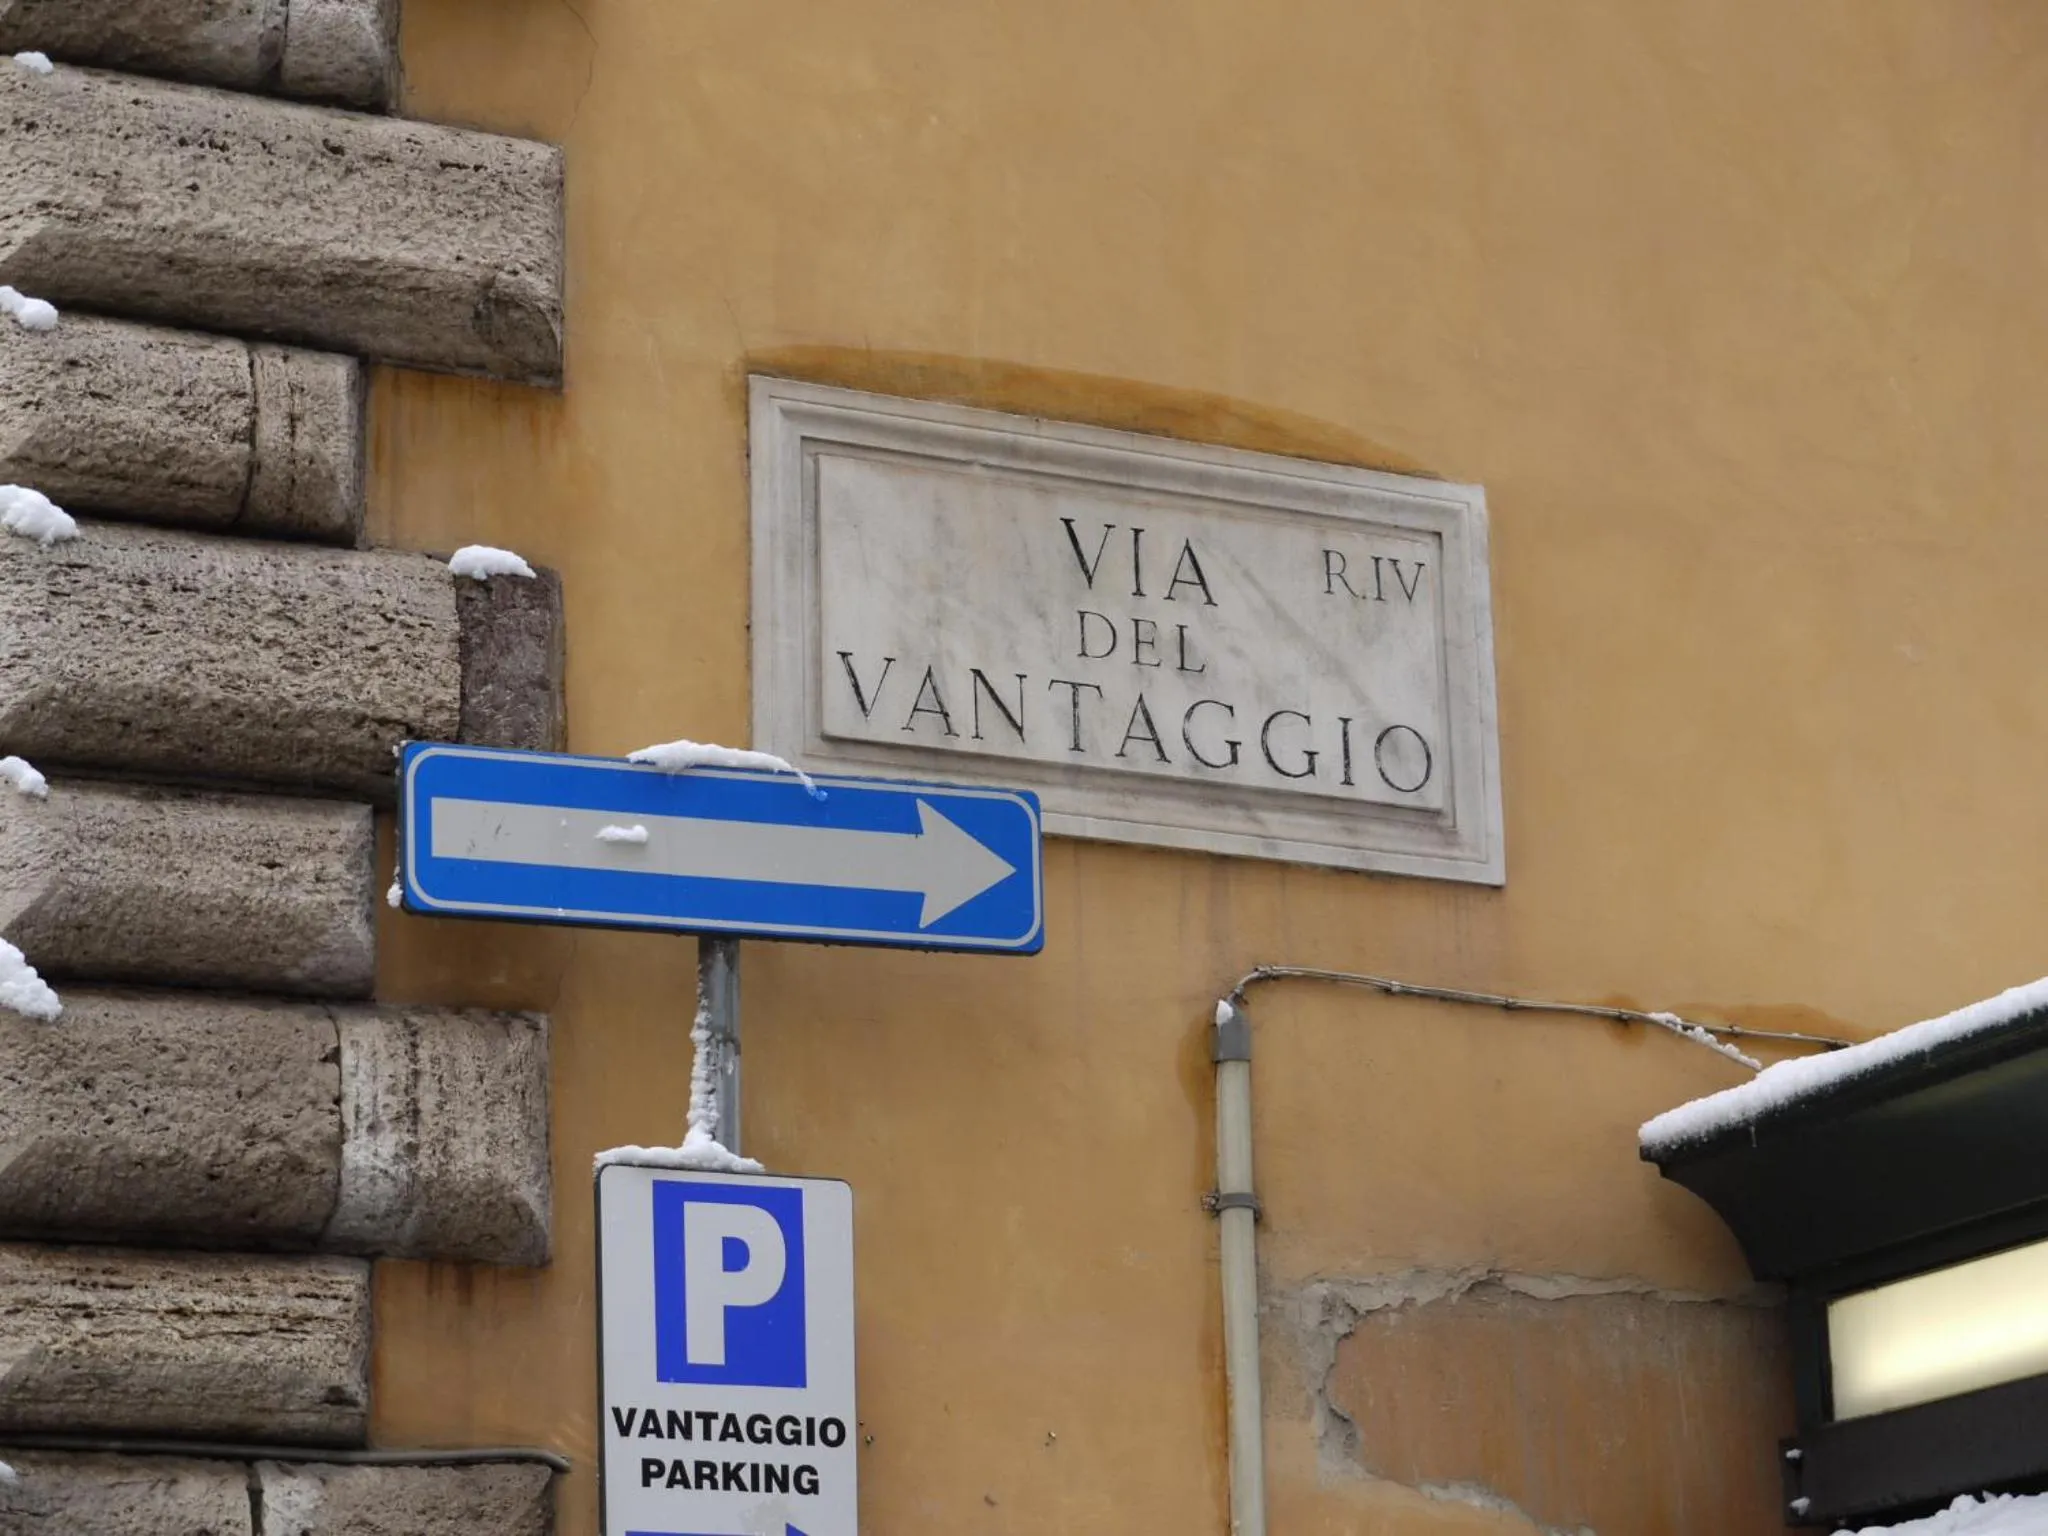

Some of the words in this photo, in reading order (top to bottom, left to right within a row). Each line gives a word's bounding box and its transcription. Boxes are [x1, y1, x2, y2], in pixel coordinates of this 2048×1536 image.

[1060, 516, 1218, 606] VIA
[1077, 610, 1207, 673] DEL
[836, 650, 1433, 793] VANTAGGIO
[683, 1201, 786, 1366] P
[611, 1406, 846, 1448] VANTAGGIO
[641, 1457, 820, 1496] PARKING
